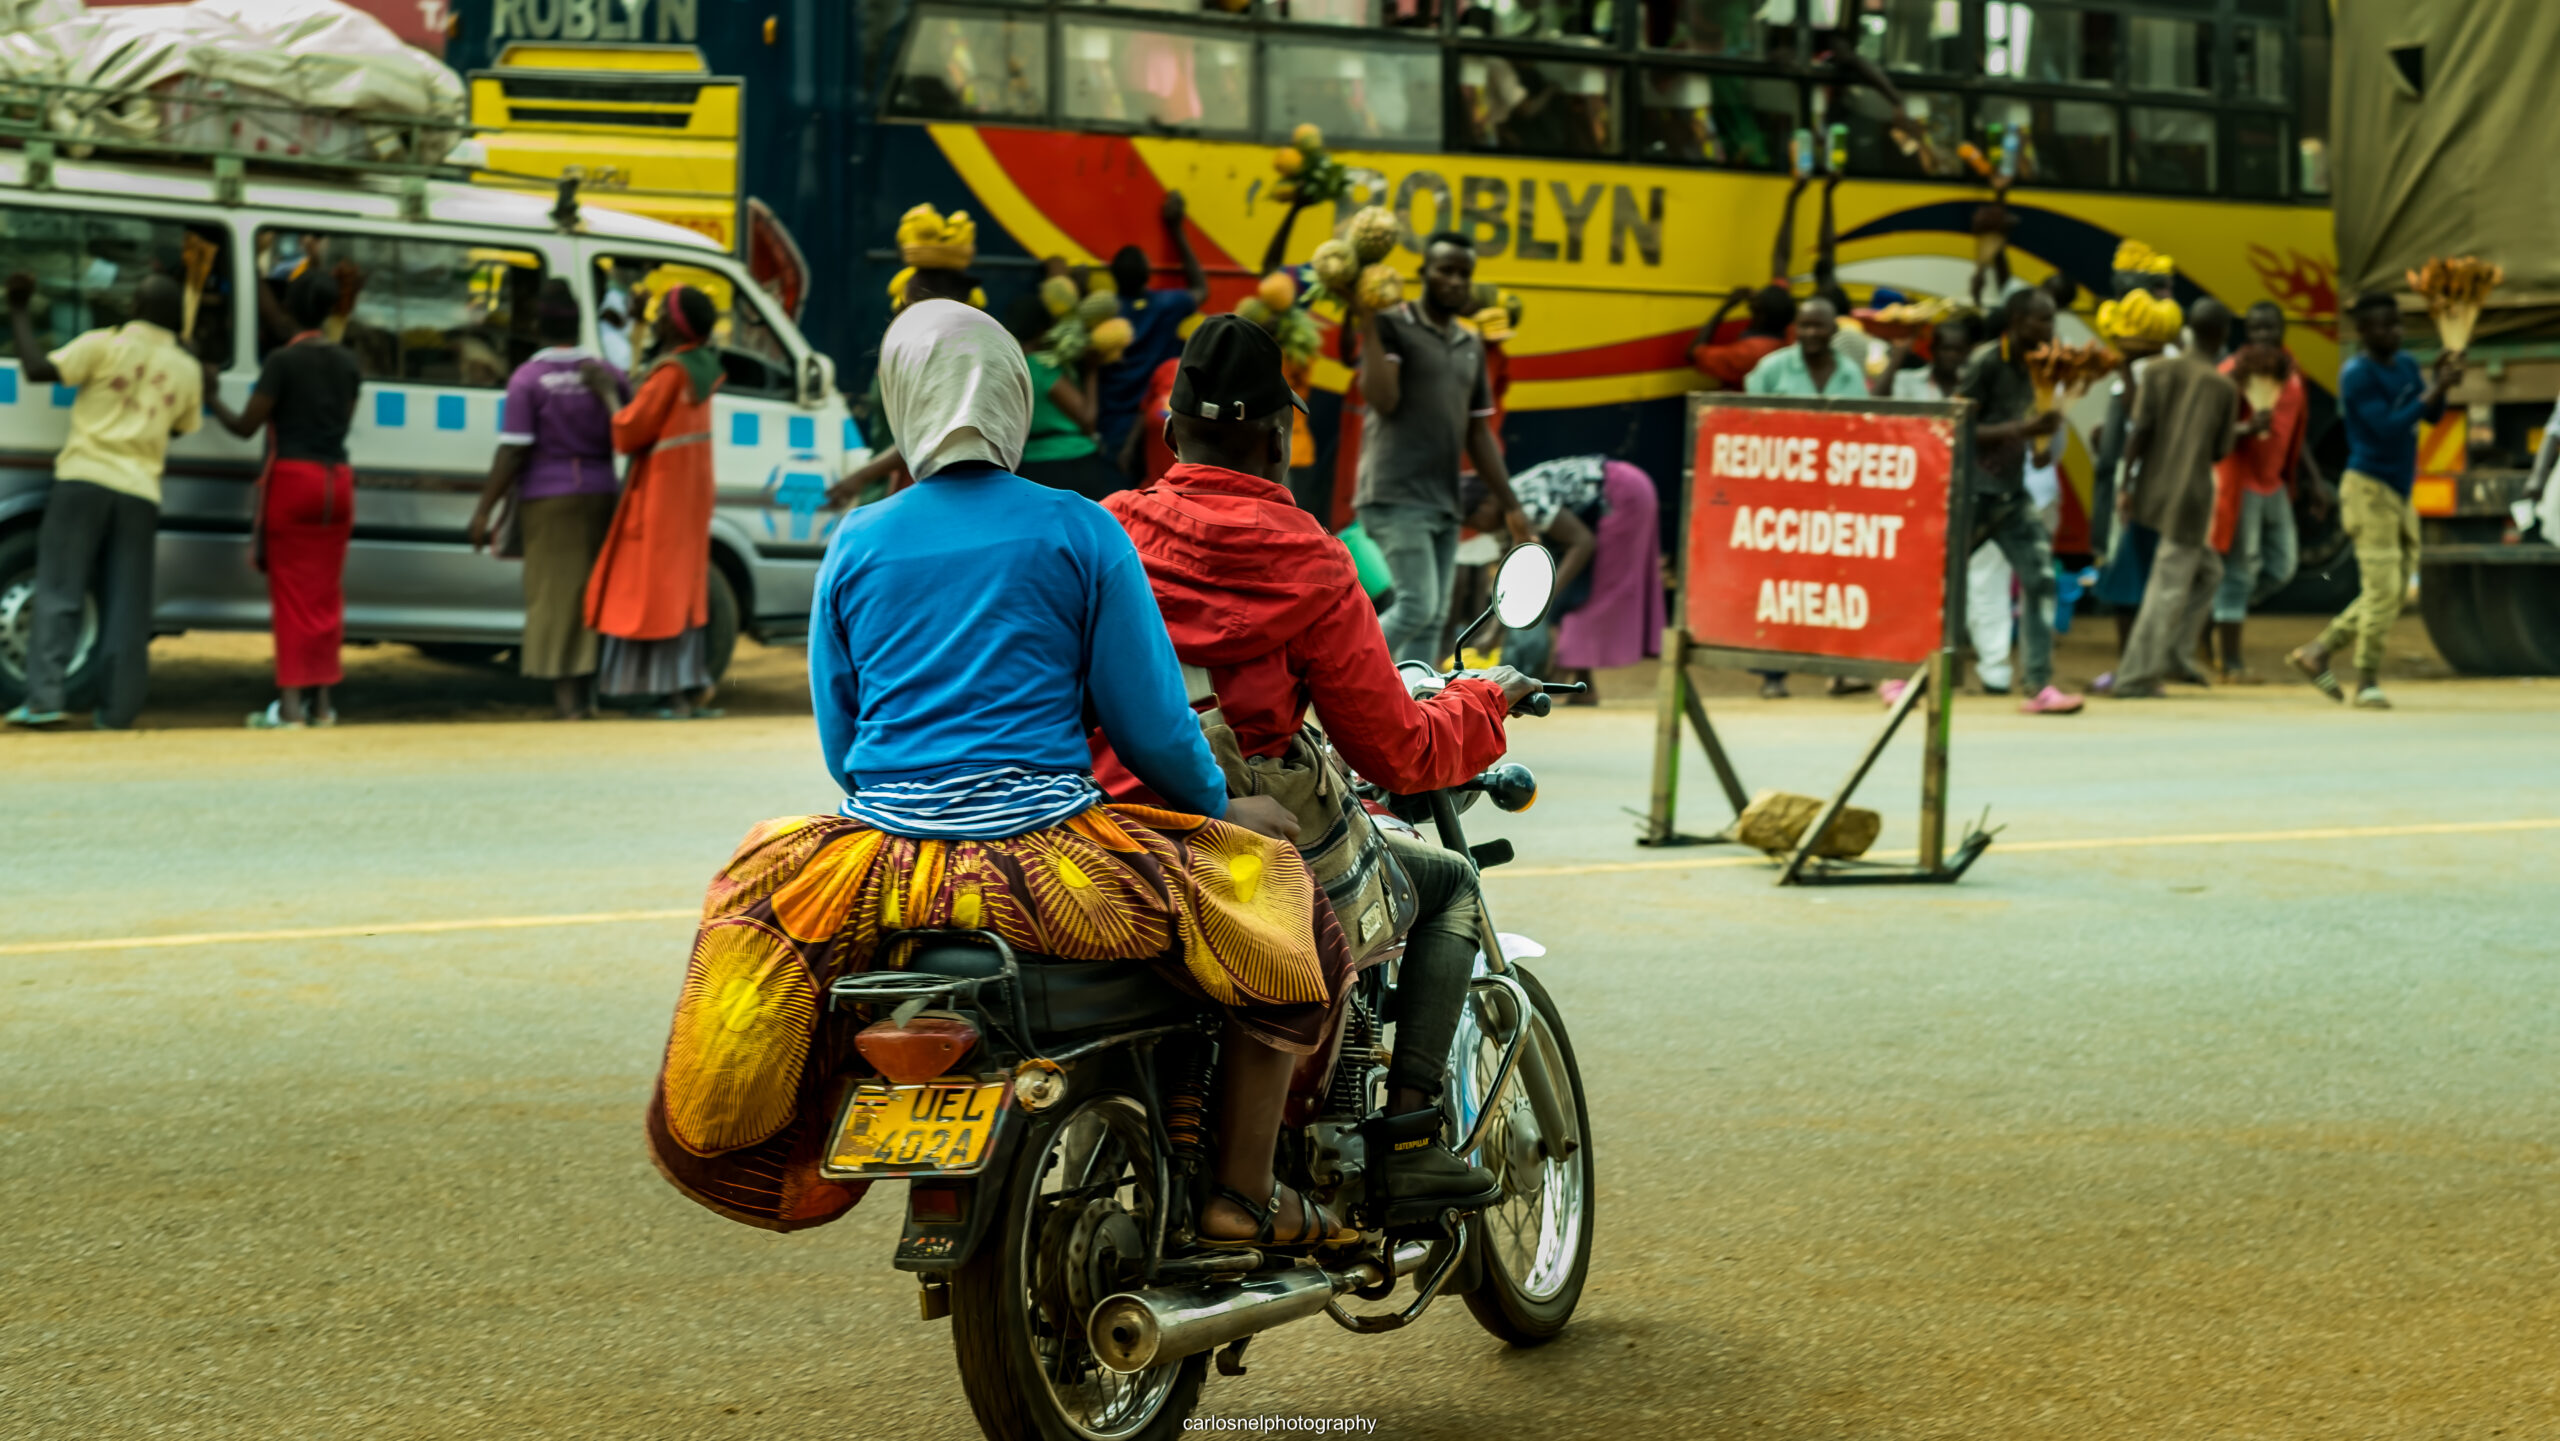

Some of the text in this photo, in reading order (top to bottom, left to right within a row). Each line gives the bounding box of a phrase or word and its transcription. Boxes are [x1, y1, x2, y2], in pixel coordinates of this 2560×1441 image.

[493, 0, 696, 40] ROBLYN
[1712, 434, 1917, 490] REDUCE SPEED
[1730, 505, 1903, 559] ACCIDENT
[1757, 579, 1869, 630] AHEAD
[911, 1088, 984, 1122] UEL
[873, 1128, 971, 1163] 402A
[1394, 1137, 1430, 1151] CATERPILLAR
